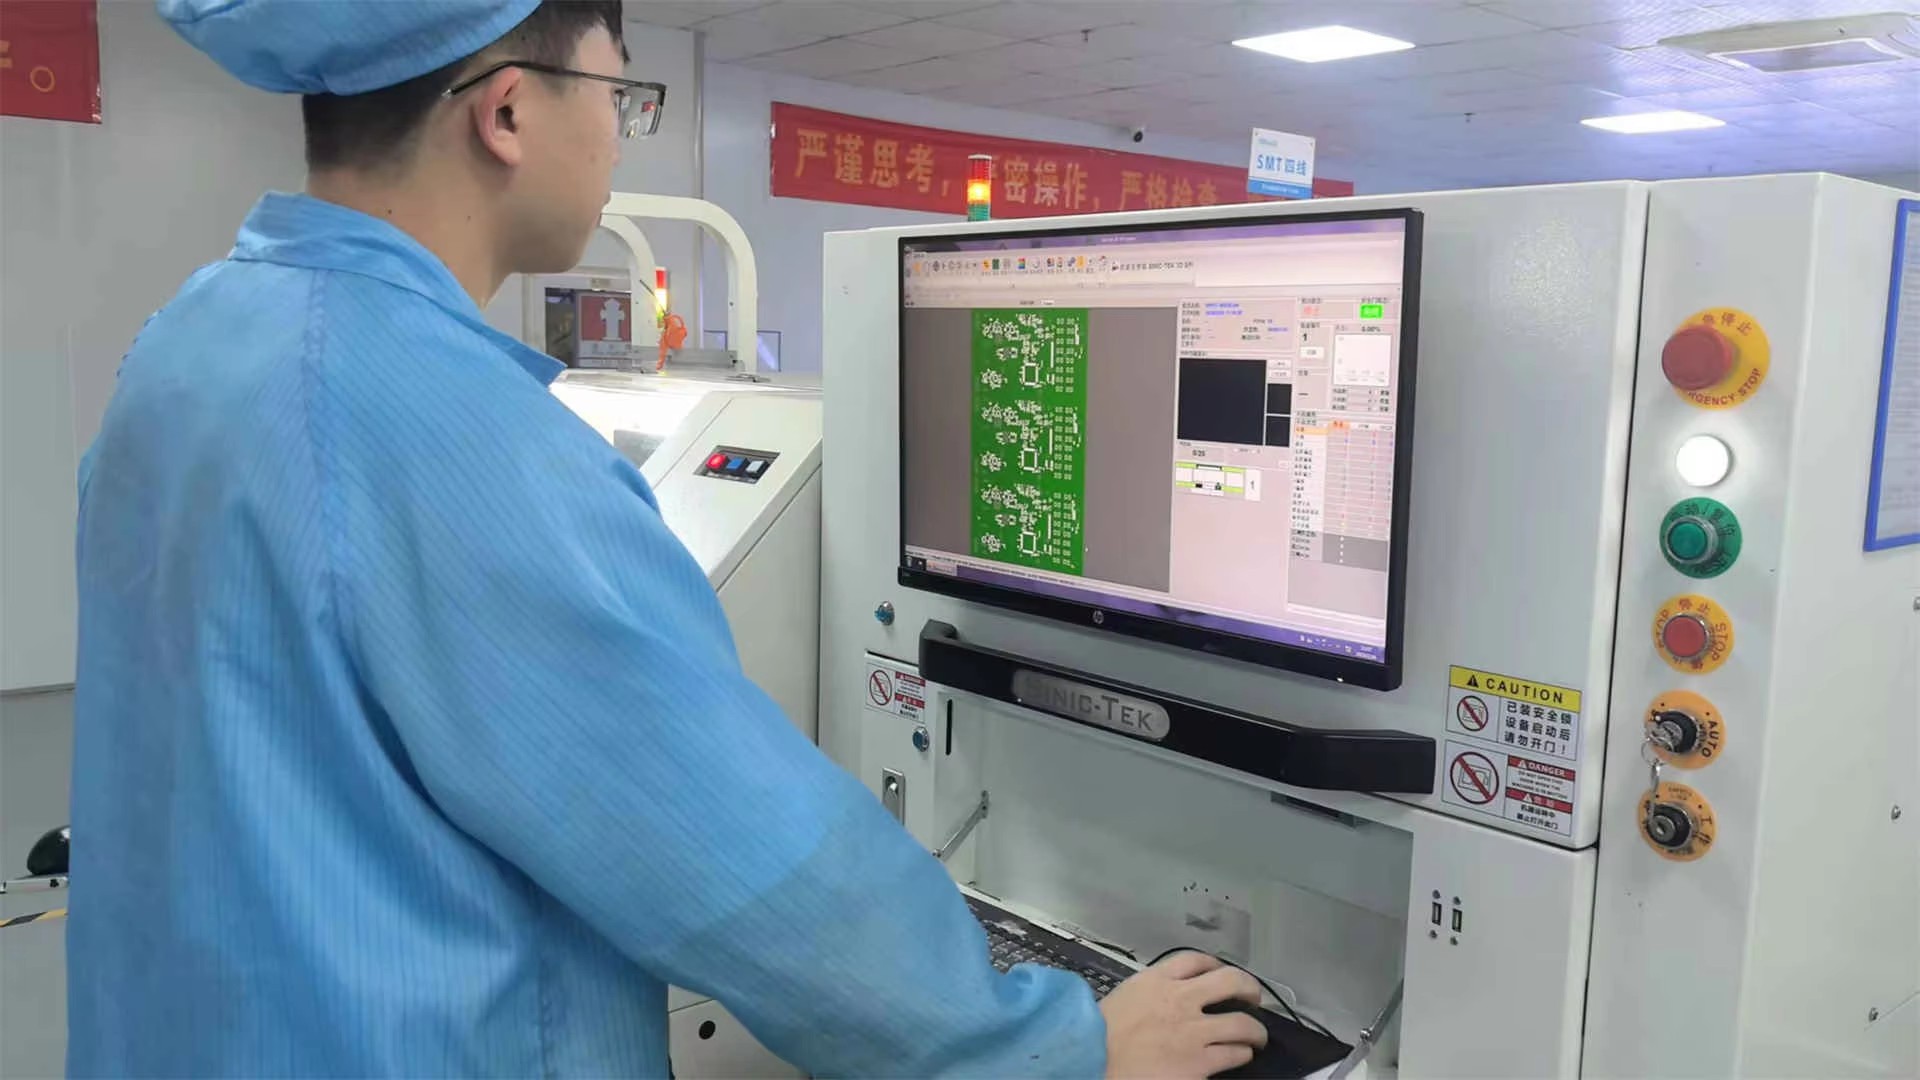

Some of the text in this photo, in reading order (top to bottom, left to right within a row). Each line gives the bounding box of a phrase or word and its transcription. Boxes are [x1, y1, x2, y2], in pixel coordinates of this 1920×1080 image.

[1485, 677, 1563, 704] CAUTION
[1506, 700, 1572, 725] 已装安全锁
[1505, 715, 1571, 741] 设备启动后
[1701, 720, 1721, 758] AUTO
[1528, 761, 1566, 777] DANGER
